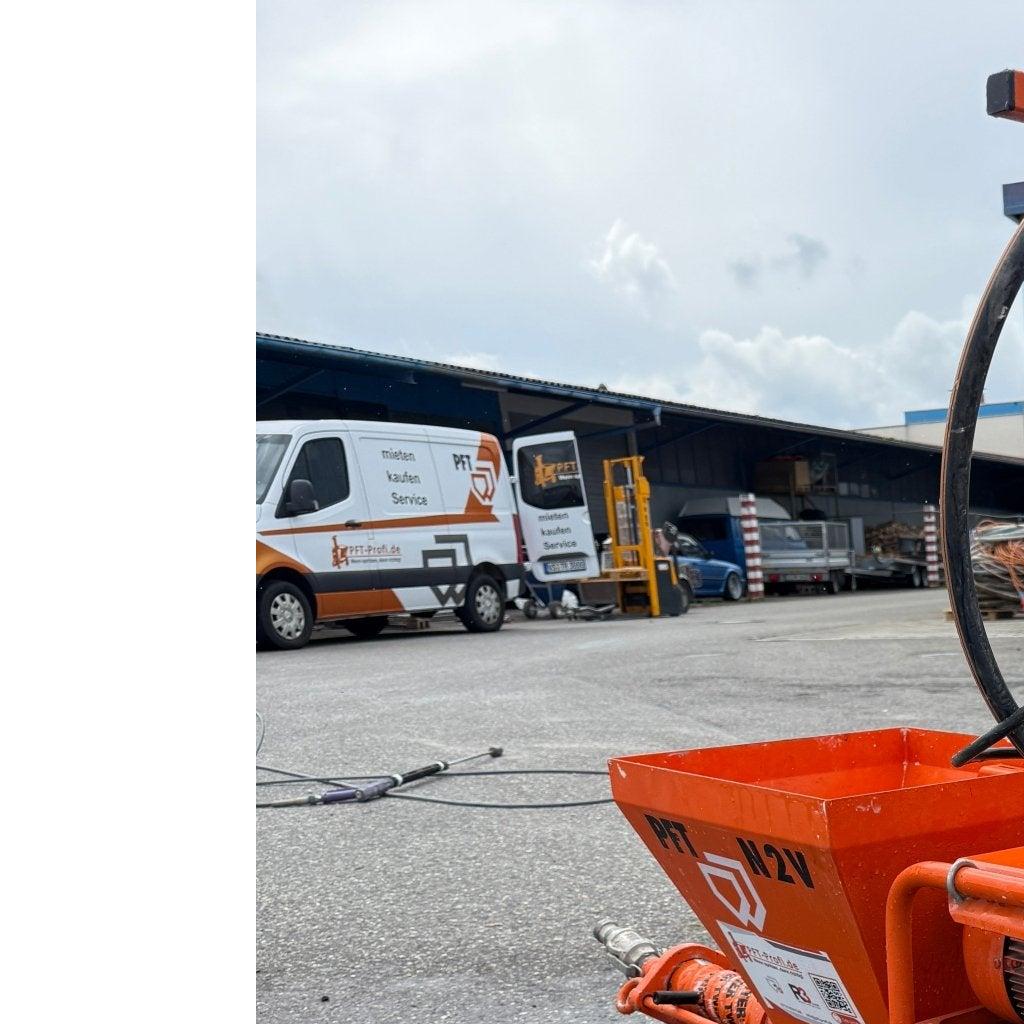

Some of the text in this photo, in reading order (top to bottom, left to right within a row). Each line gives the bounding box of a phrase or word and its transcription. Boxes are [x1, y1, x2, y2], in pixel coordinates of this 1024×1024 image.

[381, 447, 416, 461] mieten
[452, 453, 473, 471] PFT
[386, 470, 421, 484] kaufen
[391, 491, 428, 506] Service
[543, 541, 578, 551] Service
[644, 814, 699, 858] PFT
